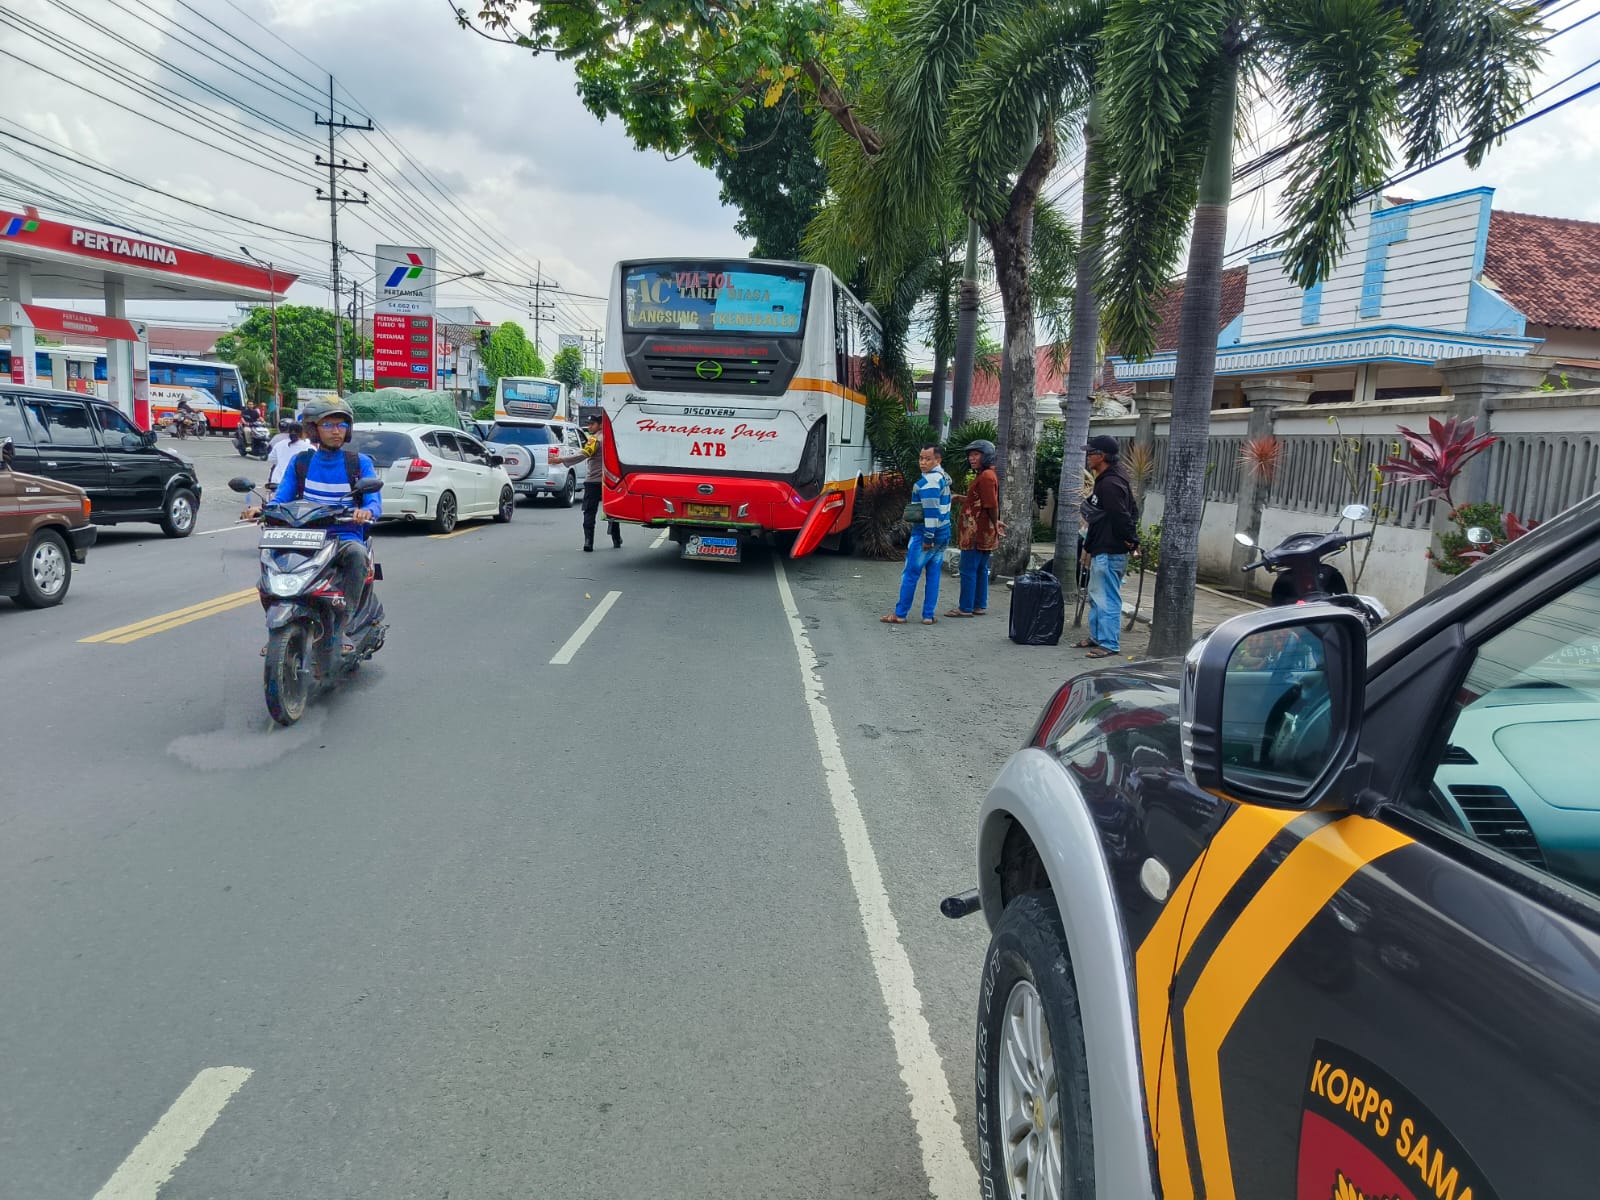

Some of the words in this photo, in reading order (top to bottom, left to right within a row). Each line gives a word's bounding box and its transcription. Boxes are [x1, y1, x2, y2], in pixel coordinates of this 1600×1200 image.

[71, 229, 178, 265] PERTAMINA
[675, 272, 700, 288] VIA
[707, 273, 735, 289] TOL
[384, 289, 423, 297] PERTAMINA
[634, 278, 672, 304] AC
[628, 310, 699, 324] LANGSUNG
[683, 407, 736, 417] DISCOVERY
[636, 419, 726, 436] Harapan
[731, 423, 779, 443] Jaya
[690, 441, 727, 458] ATB
[1310, 1059, 1393, 1137] KORPS
